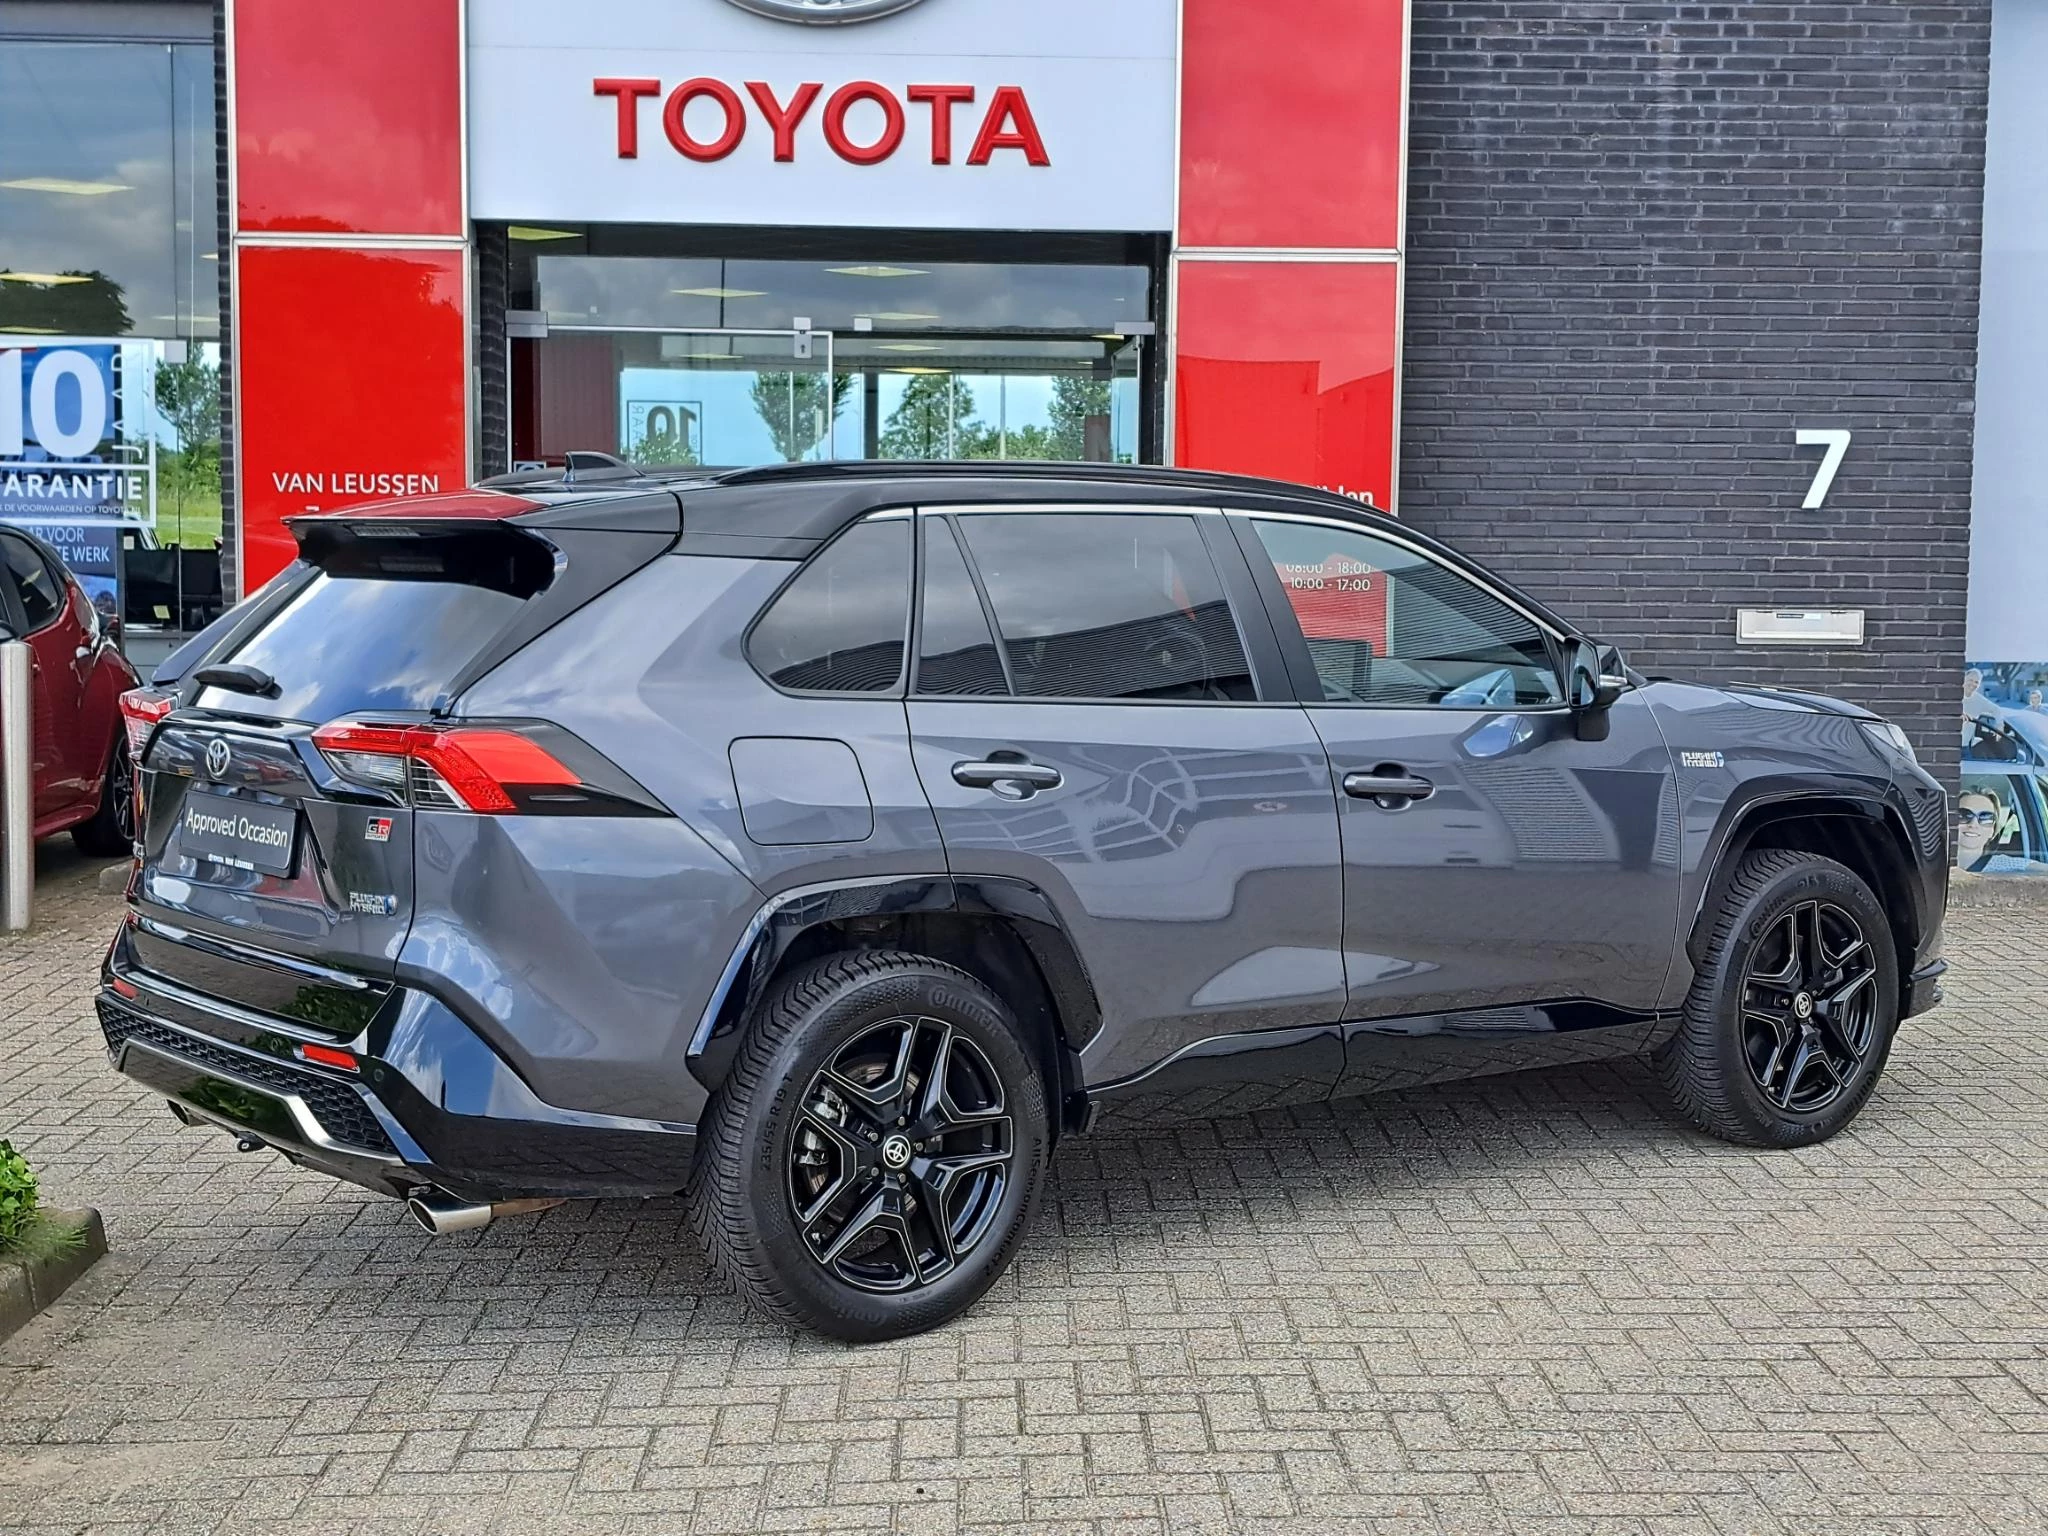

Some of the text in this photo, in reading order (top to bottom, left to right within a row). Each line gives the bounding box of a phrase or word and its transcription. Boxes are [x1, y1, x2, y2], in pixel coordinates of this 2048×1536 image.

[593, 77, 1051, 166] TOYOTA
[0, 349, 106, 458] 10
[1796, 429, 1851, 509] 7
[2, 473, 142, 499] ARANTIE
[272, 472, 439, 495] VAN LEUSSEN
[4, 504, 15, 512] DE
[17, 504, 83, 513] VOORWAARDEN
[46, 527, 85, 542] VOOR
[72, 546, 110, 562] WERK
[1337, 561, 1371, 574] 18:00
[1291, 577, 1324, 590] 10:00
[1336, 578, 1371, 591] 17:00
[185, 806, 288, 848] Approved Occasion
[366, 823, 390, 836] GR
[761, 1121, 777, 1171] 235/55
